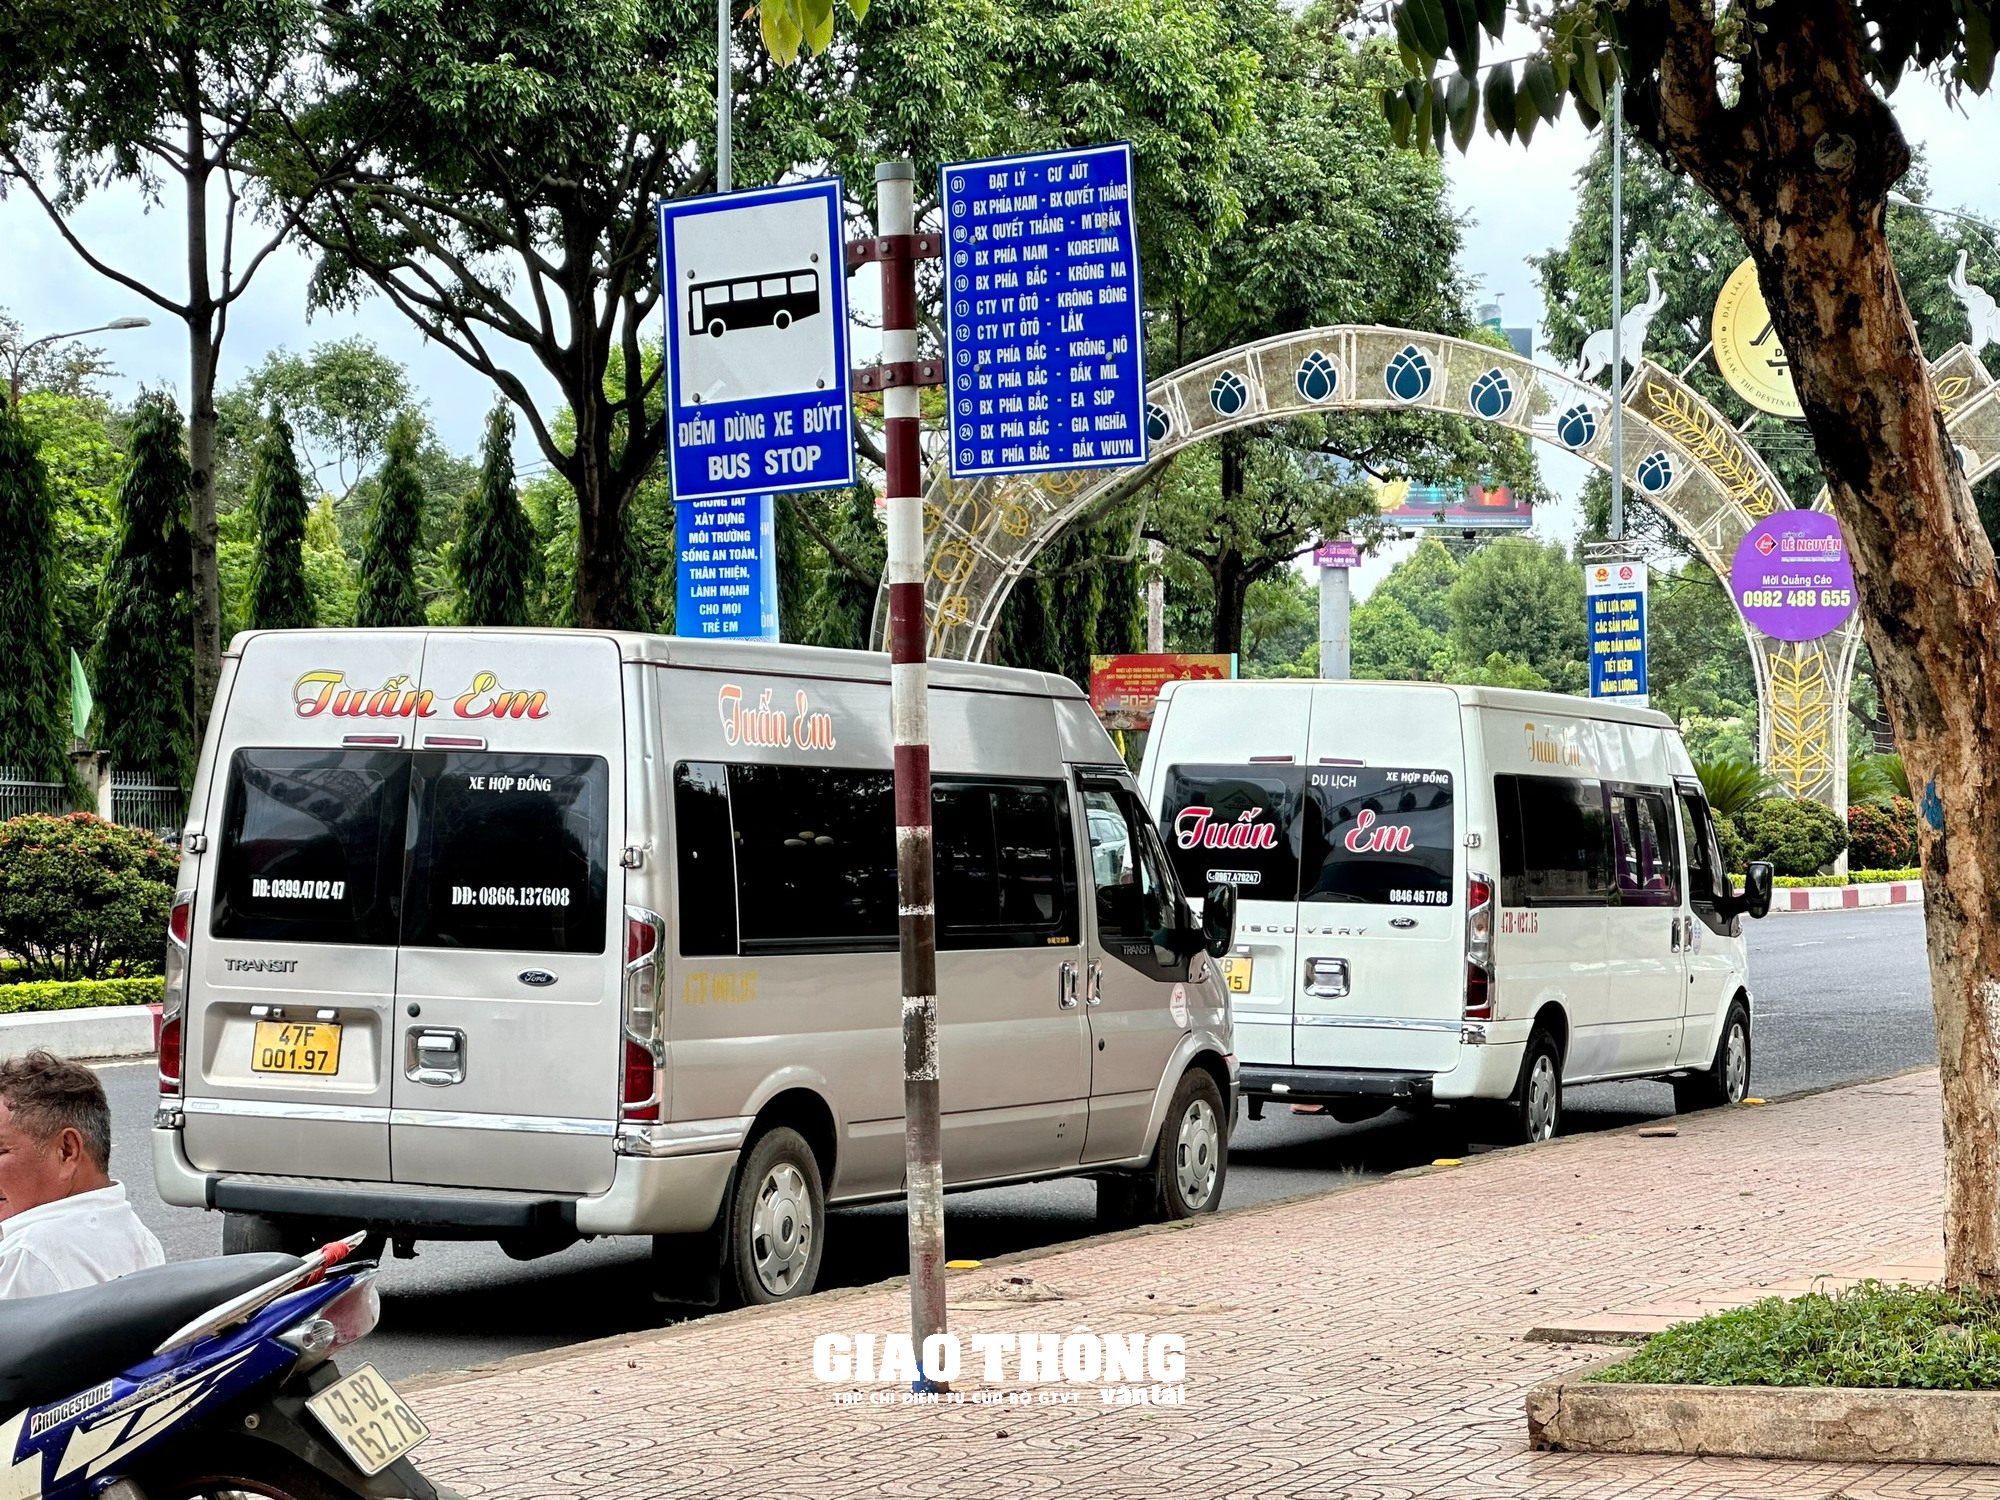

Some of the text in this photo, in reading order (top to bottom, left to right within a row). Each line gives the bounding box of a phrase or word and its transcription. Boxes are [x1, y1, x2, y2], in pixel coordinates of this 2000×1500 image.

[989, 161, 1088, 192] ĐẠT LÝ CƯ JÚT
[974, 180, 1127, 216] BX PHÍA NAM BX QUYẾT THẮNG
[974, 226, 988, 241] BX
[993, 217, 1023, 239] QUYẾT
[1029, 213, 1063, 236] THẮNG
[975, 237, 1119, 265] BX PHÍA NAM KOREVINA
[976, 262, 1126, 290] BX PHÍA BẮC KRÔNG NA
[1002, 299, 1014, 313] VT
[1019, 293, 1038, 310] ÔTÔ
[1058, 289, 1093, 308] KRÔNG
[1099, 287, 1127, 303] BÔNG
[1002, 323, 1015, 338] VT
[1020, 318, 1039, 336] ÔTÔ
[1061, 309, 1084, 333] LẮK
[978, 335, 1127, 364] BX PHÍA BẮC KRÔNG NÔ
[979, 361, 1119, 389] BX PHÍA BẮC ĐẮK MIL
[980, 387, 1115, 415] BX PHÍA BẮC EA SÚP
[679, 402, 843, 447] ĐIỂM DỪNG XE BÚYT
[980, 412, 1127, 439] BX PHÍA BẮC GIA NGHĨA
[981, 437, 1133, 464] BX PHÍA BẮC ĐẮK WUYN
[708, 445, 821, 481] BUS STOP
[695, 512, 744, 527] XÂY DỰNG
[689, 528, 750, 543] MÔI TRƯỜNG
[682, 546, 758, 562] SỐNG AN TOÀN,
[690, 566, 750, 580] THÂN THIỆN,
[1763, 574, 1832, 586] Mời Quảng Cáo
[691, 584, 749, 598] LÀNH MẠNH
[1743, 590, 1850, 607] 0982 488 655
[699, 603, 741, 617] CHO MỌI
[702, 619, 738, 632] TRẺ EM
[293, 670, 550, 719] Tuấn Em
[719, 684, 836, 750] Tuấn Em
[469, 773, 551, 794] XE HỢP ĐỒNG
[1312, 774, 1357, 788] DU LỊCH
[1386, 770, 1448, 784] XE HỢP ĐỒNG
[1175, 806, 1278, 849] Tuấn
[1345, 809, 1414, 852] Em
[452, 887, 570, 906] DĐ: 0866.137608
[1390, 889, 1412, 902] 0846
[1242, 924, 1368, 935] ISCOVERY
[1394, 918, 1412, 926] Ford
[1123, 945, 1150, 955] TRANSIT
[224, 958, 297, 972] TRANSIT
[522, 971, 547, 983] Ford
[278, 1025, 315, 1046] 47F
[262, 1050, 328, 1071] 001.97
[31, 1382, 112, 1437] BRIDGESTONE
[325, 1374, 388, 1427] 47-B2
[347, 1406, 422, 1467] 152.78
